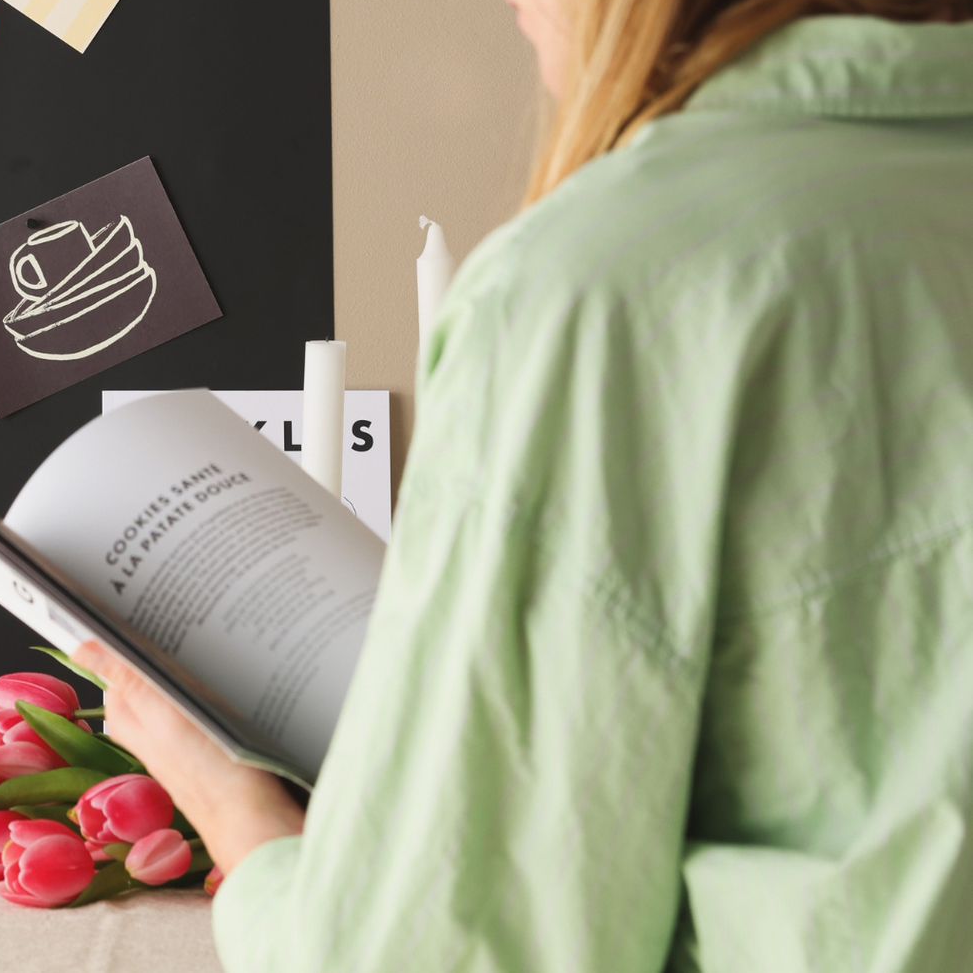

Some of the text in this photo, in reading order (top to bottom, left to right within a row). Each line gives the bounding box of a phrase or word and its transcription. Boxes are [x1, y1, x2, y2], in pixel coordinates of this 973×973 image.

[105, 494, 170, 566] COOKIES
[121, 554, 143, 577] LA
[140, 501, 195, 552] PATATE
[194, 472, 251, 503] DOUCE
